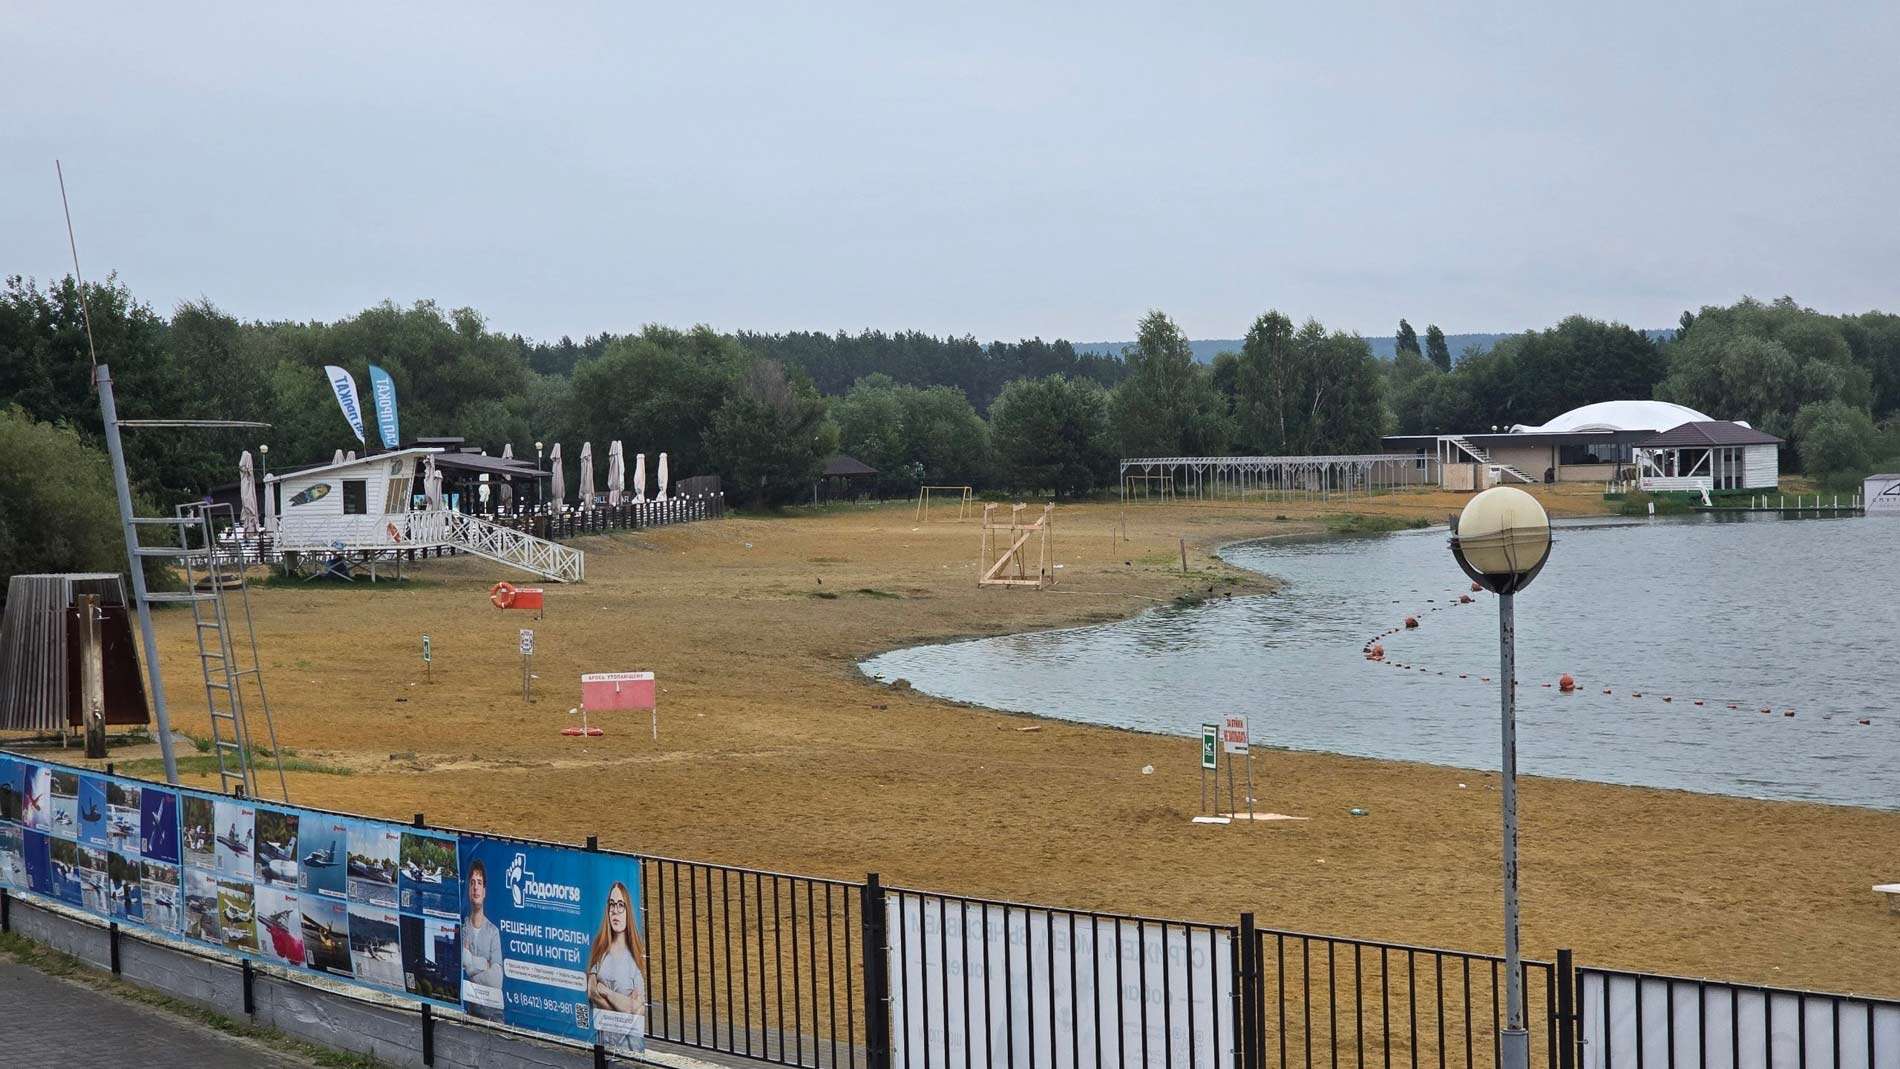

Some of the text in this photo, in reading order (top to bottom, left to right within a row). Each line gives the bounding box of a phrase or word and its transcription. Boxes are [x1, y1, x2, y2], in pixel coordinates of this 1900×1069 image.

[500, 919, 590, 946] РЕШЕНИЕ ПРОБЛЕМ
[510, 940, 581, 963] СТОП И НОГТЕЙ
[513, 993, 573, 1015] 8 (8412) 982-981
